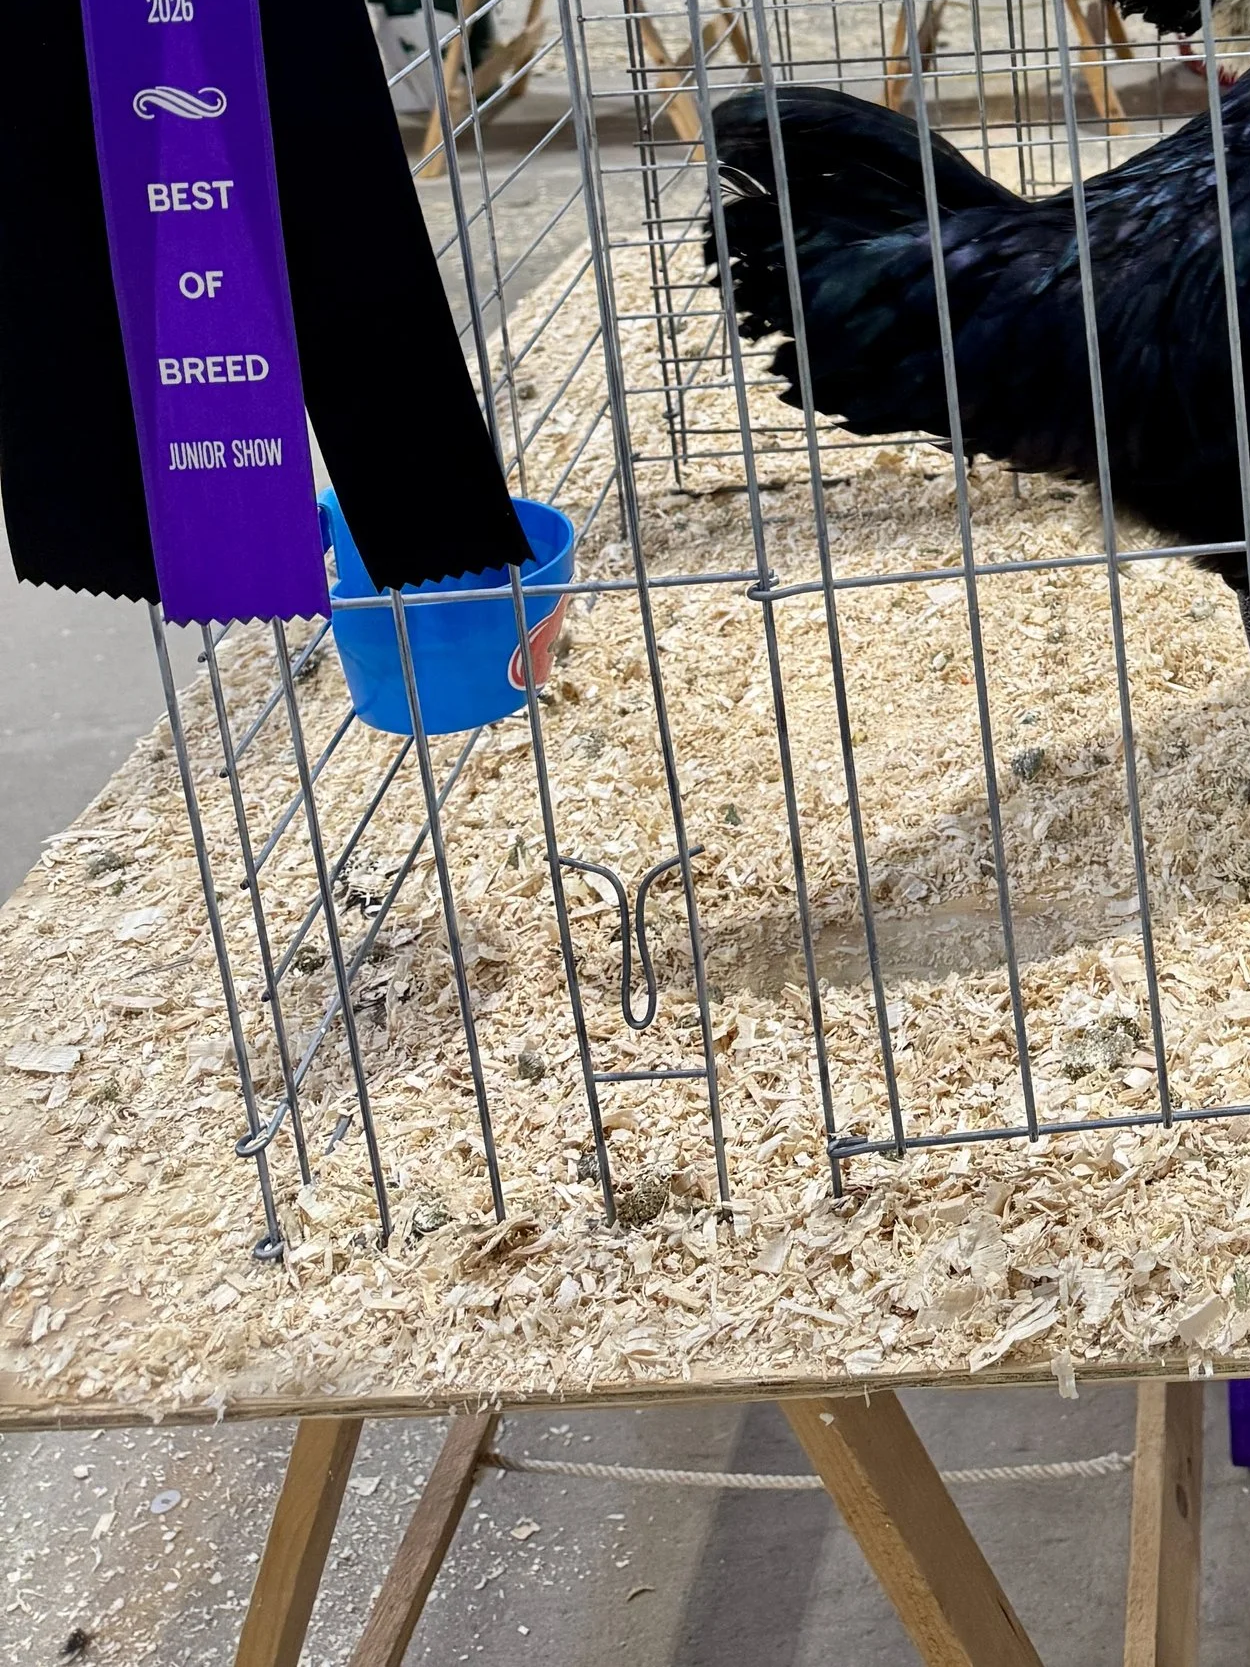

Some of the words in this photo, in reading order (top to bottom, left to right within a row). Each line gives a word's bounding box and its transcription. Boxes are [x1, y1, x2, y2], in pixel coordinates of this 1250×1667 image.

[147, 180, 234, 212] BEST
[179, 270, 224, 300] OF
[158, 354, 270, 385] BREED
[169, 441, 227, 471] JUNIOR
[232, 438, 282, 468] SHOW
